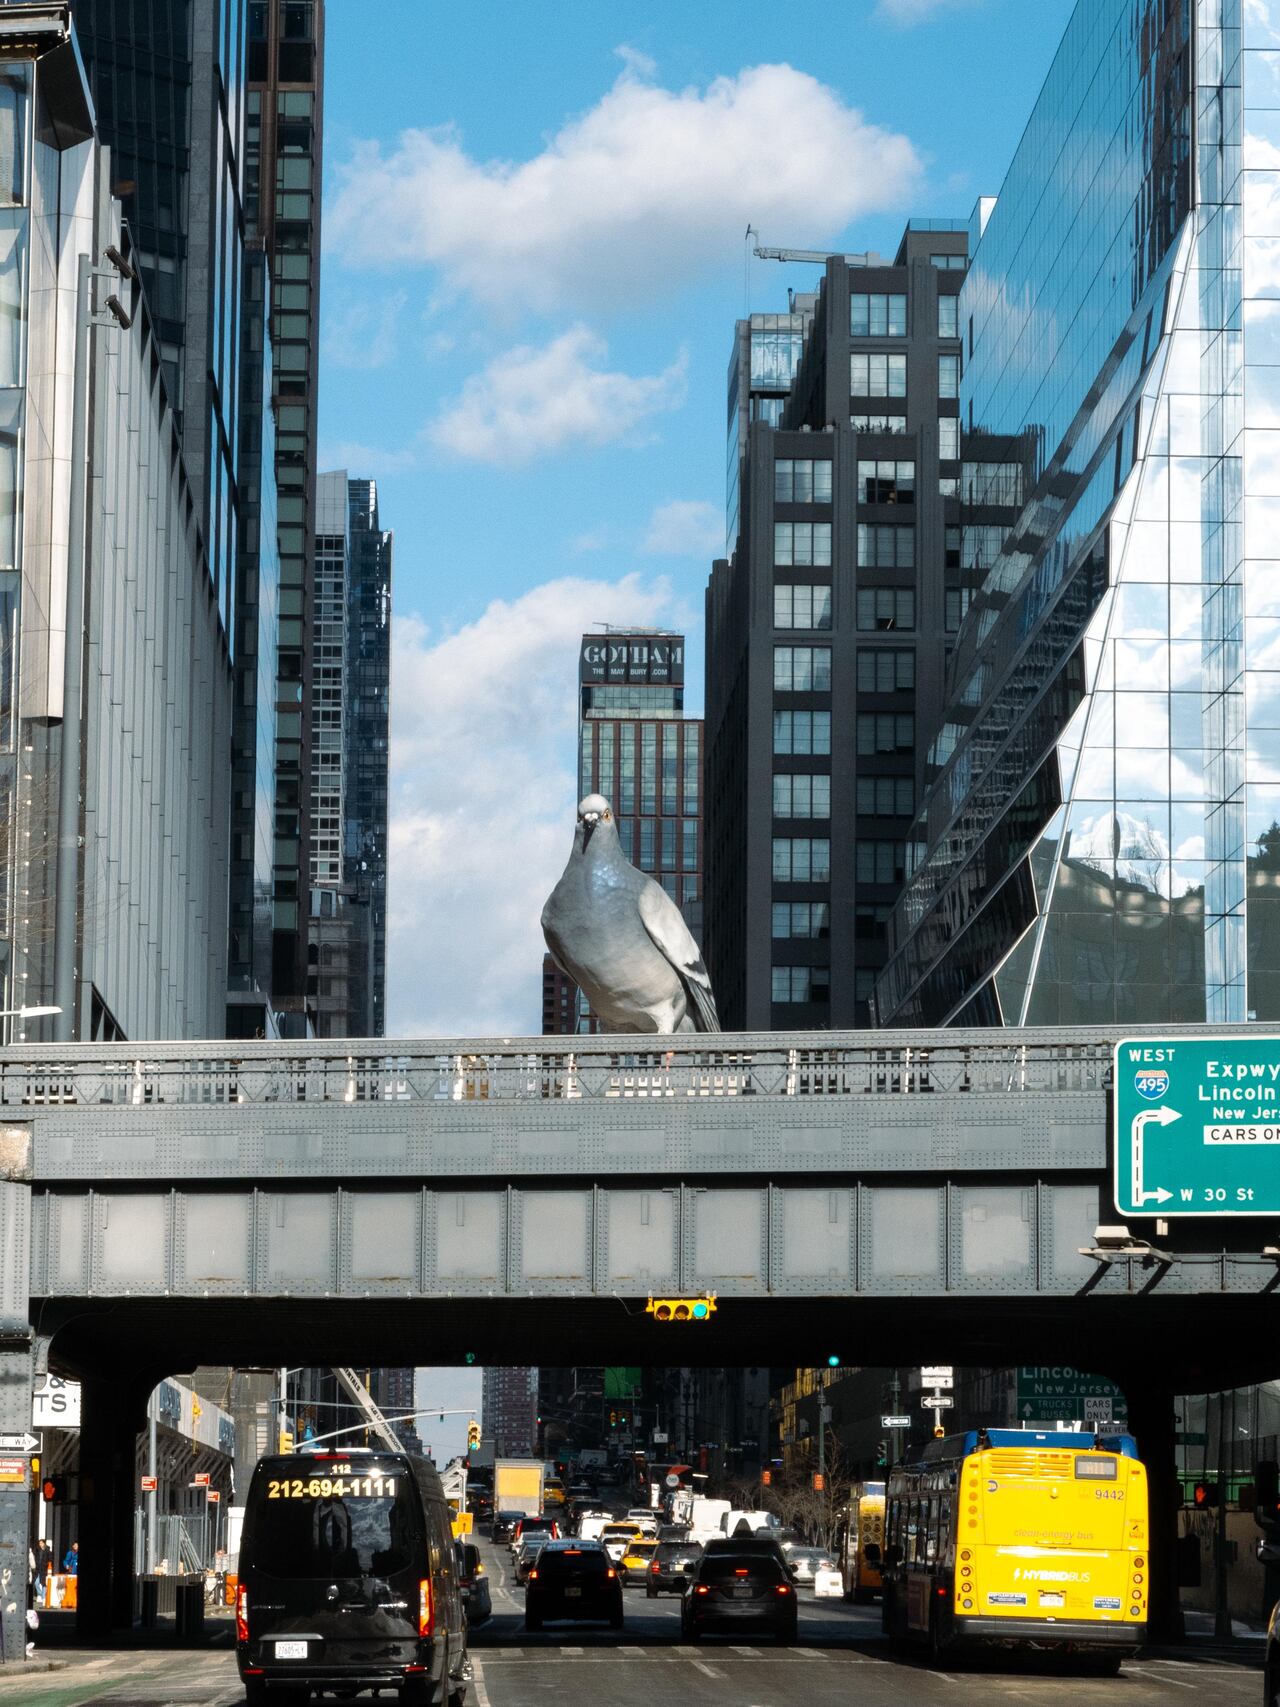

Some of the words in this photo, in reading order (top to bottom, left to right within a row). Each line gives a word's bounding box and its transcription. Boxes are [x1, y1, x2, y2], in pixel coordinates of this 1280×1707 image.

[584, 646, 682, 664] GOTHAM
[1129, 1049, 1175, 1062] WEST
[1207, 1061, 1280, 1081] Expwy
[1138, 1078, 1166, 1091] 495
[1199, 1085, 1276, 1101] Lincoln
[1213, 1107, 1245, 1119] New
[1252, 1106, 1280, 1119] Jer
[1211, 1129, 1257, 1141] CARS
[1181, 1189, 1193, 1201] W
[1205, 1189, 1226, 1201] 30
[1237, 1188, 1254, 1201] St
[1034, 1384, 1063, 1394] New
[1069, 1384, 1119, 1396] Jersey
[1039, 1400, 1073, 1408] TRUCKS
[1086, 1400, 1111, 1408] CARS
[1040, 1410, 1071, 1419] BUSES
[1087, 1411, 1110, 1419] ONLY
[14, 1438, 32, 1446] WAY
[332, 1464, 351, 1474] 112
[268, 1479, 395, 1498] 212-694-1111
[1095, 1490, 1124, 1501] 9442
[1014, 1529, 1072, 1540] clean-energy
[1076, 1530, 1094, 1540] bus
